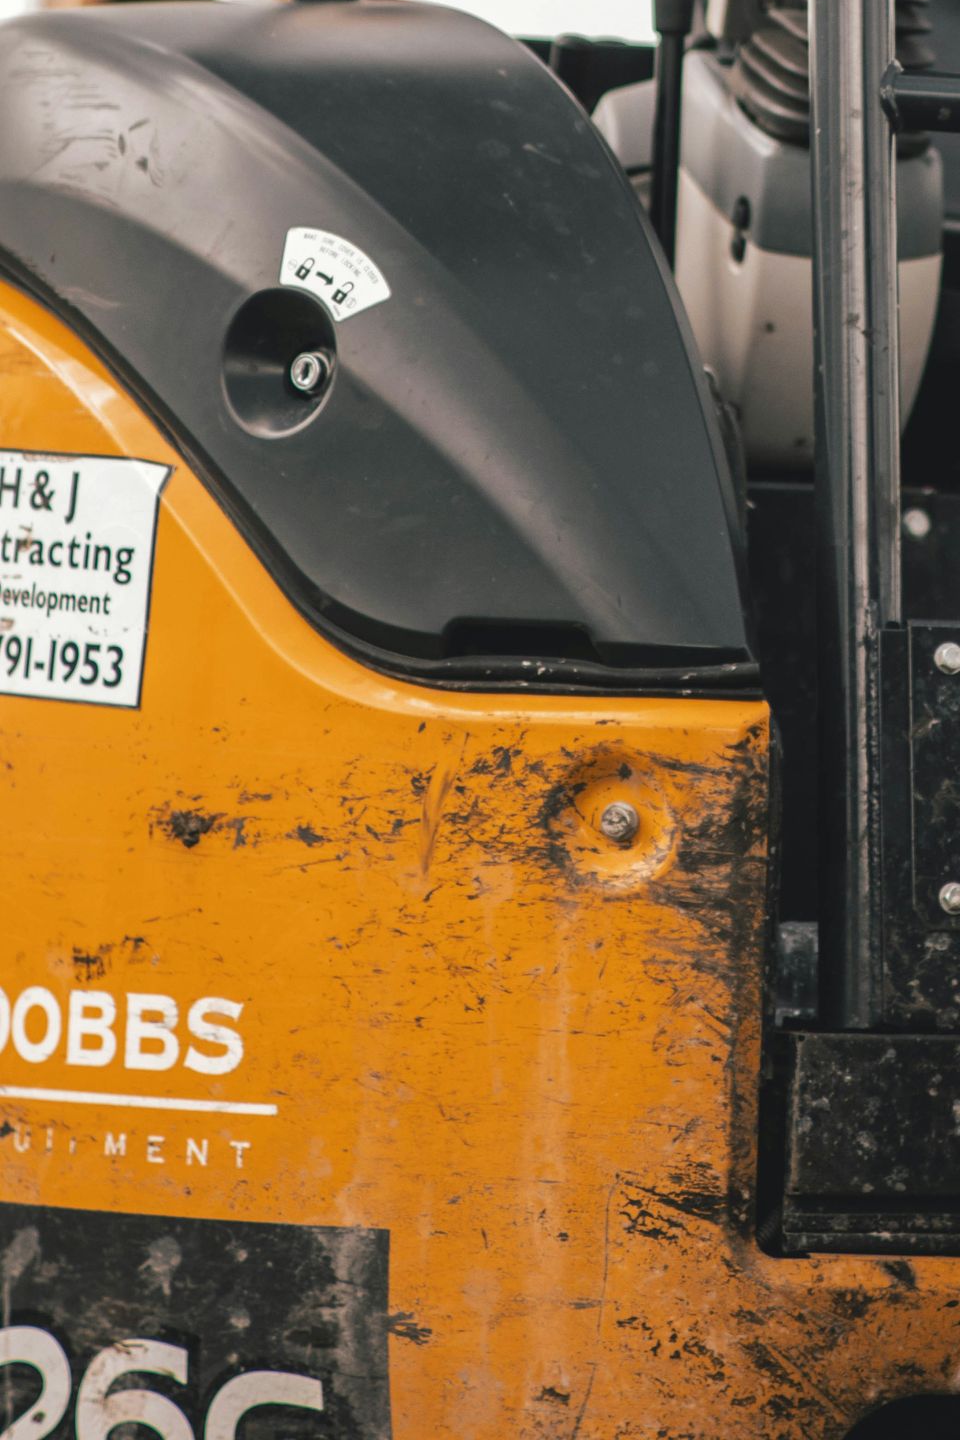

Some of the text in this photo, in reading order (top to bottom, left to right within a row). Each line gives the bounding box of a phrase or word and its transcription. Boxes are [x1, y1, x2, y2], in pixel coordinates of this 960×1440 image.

[0, 466, 80, 525] H & J
[0, 532, 135, 585] tracting
[0, 582, 111, 617] evelopment
[0, 633, 124, 688] 91-1953
[0, 986, 245, 1075] OBBS
